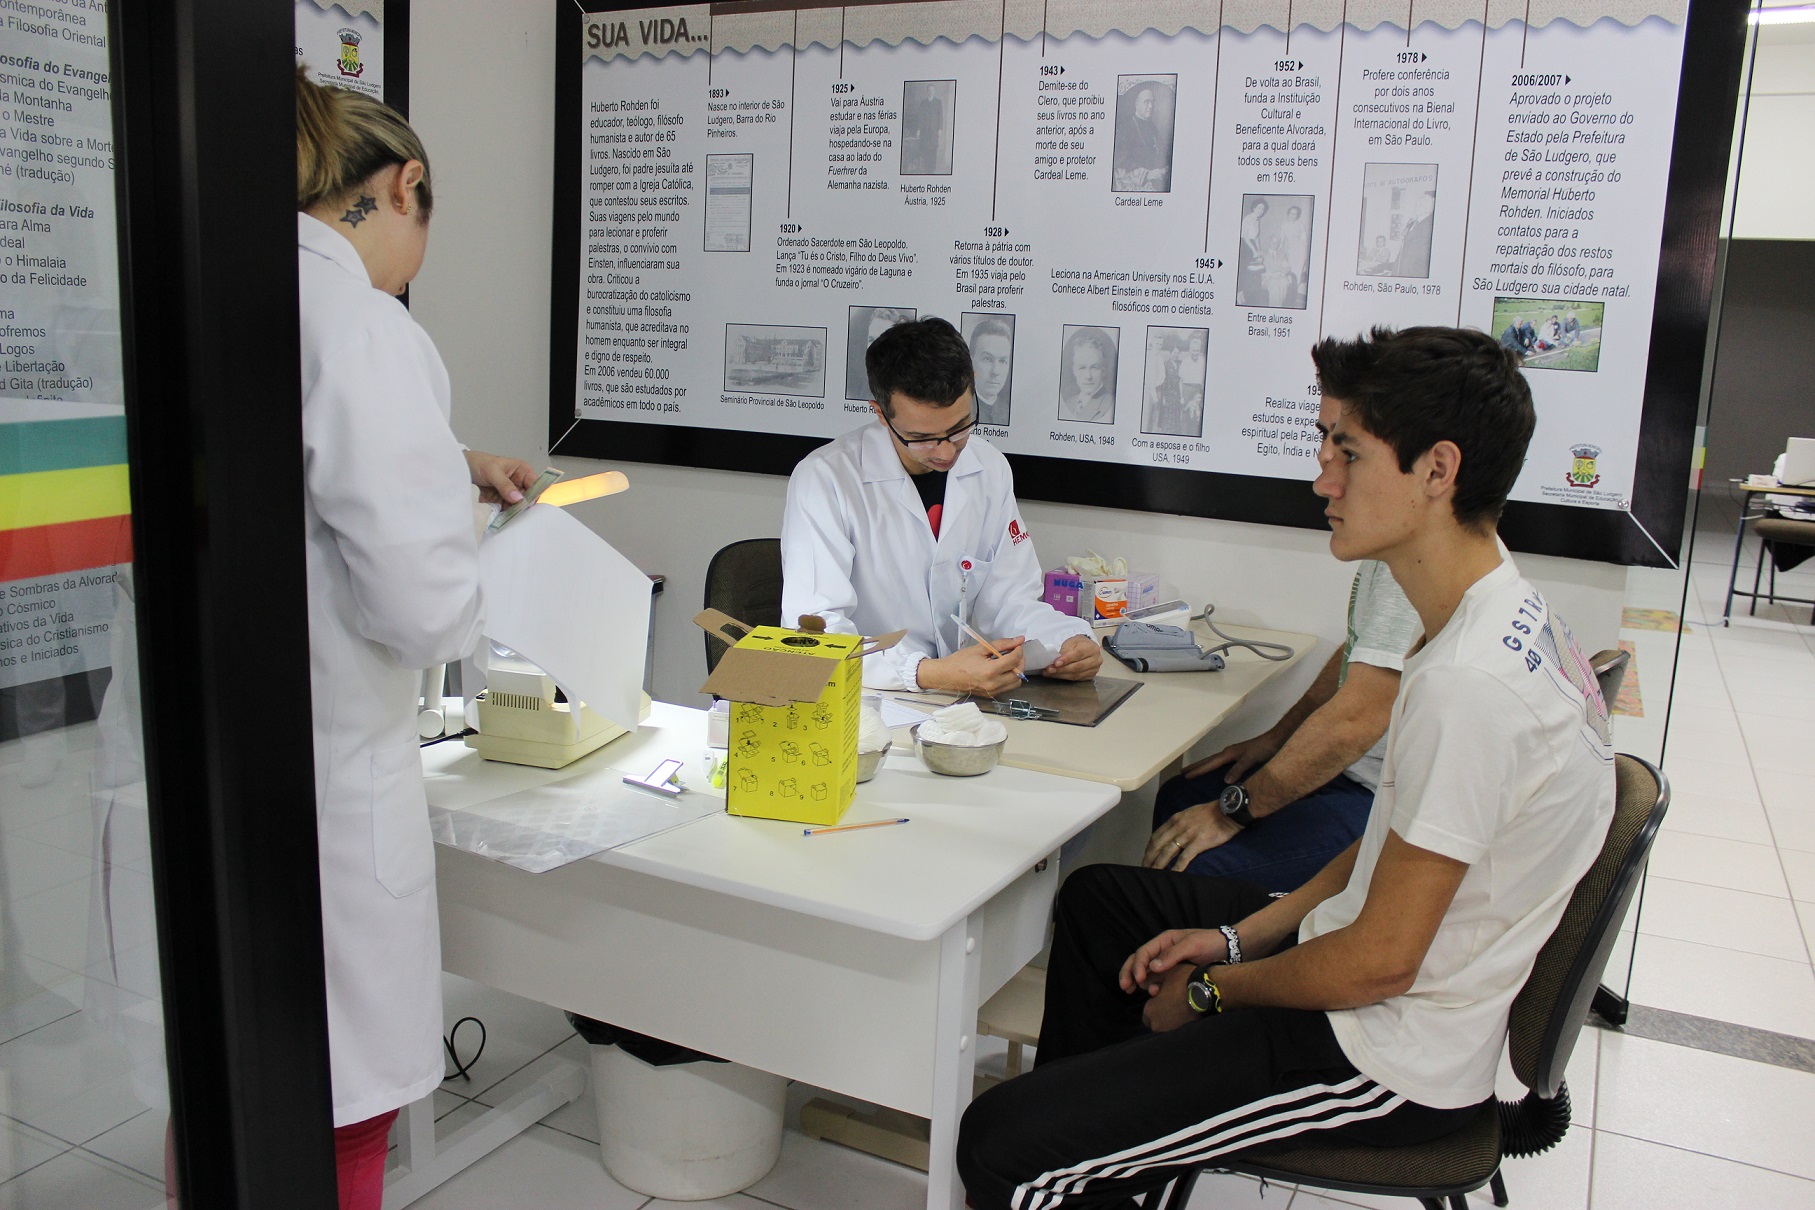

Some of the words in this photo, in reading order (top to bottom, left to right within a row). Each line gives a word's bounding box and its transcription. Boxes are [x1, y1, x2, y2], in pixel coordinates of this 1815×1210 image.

[8, 15, 58, 38] Filosofia
[62, 28, 106, 48] Oriental
[587, 22, 630, 49] SUA
[639, 17, 709, 46] VIDA...
[1397, 52, 1418, 63] 1978
[1040, 65, 1058, 76] 1943
[1274, 60, 1295, 72] 1952
[1363, 69, 1395, 80] Profere
[1397, 68, 1450, 80] conferência
[1511, 74, 1562, 86] 2006/2007
[39, 78, 54, 91] do
[1038, 80, 1077, 91] Demite-se
[1079, 80, 1089, 90] do
[1245, 76, 1257, 88] De
[1260, 77, 1280, 88] volta
[1282, 79, 1293, 87] ao
[1295, 76, 1321, 88] Brasil,
[709, 89, 724, 98] 1893
[832, 84, 848, 94] 1925
[14, 91, 72, 112] Montanha
[591, 101, 619, 112] Huberto
[620, 100, 649, 111] Rohden
[650, 98, 659, 110] foi
[708, 102, 728, 112] Nasce
[729, 103, 737, 111] no
[738, 101, 761, 110] interior
[761, 100, 770, 110] de
[771, 99, 785, 109] São
[830, 97, 841, 107] Vai
[843, 99, 858, 109] para
[1509, 92, 1561, 108] Aprovado
[1564, 95, 1571, 105] o
[1573, 92, 1612, 108] projeto
[2, 111, 10, 120] o
[14, 109, 54, 127] Mestre
[707, 115, 735, 127] Ludgero,
[736, 114, 754, 124] Barra
[755, 114, 764, 123] do
[765, 113, 776, 123] Rio
[1261, 108, 1294, 119] Cultural
[1295, 110, 1301, 119] e
[1508, 111, 1550, 124] enviado
[1552, 114, 1567, 124] ao
[1570, 111, 1617, 124] Governo
[1619, 111, 1634, 124] do
[590, 117, 624, 128] educador,
[626, 116, 655, 129] teólogo,
[657, 114, 684, 126] filósofo
[1236, 123, 1285, 135] Beneficente
[1286, 124, 1326, 135] Alvorada,
[10, 127, 37, 142] Vida
[40, 133, 73, 147] sobre
[76, 139, 83, 148] a
[590, 132, 626, 144] humanista
[628, 134, 633, 143] e
[634, 132, 654, 143] autor
[655, 131, 664, 142] de
[666, 130, 676, 142] 65
[16, 164, 75, 185] (tradução)
[1034, 169, 1063, 180] Cardeal
[1065, 170, 1088, 180] Leme.
[827, 180, 861, 190] Alemanha
[863, 180, 889, 190] nazista.
[900, 184, 925, 193] Huberto
[926, 184, 951, 193] Rohden
[1501, 186, 1551, 200] Memorial
[1552, 188, 1595, 201] Huberto
[931, 196, 946, 206] 1925
[1115, 196, 1142, 206] Cardeal
[1143, 197, 1163, 207] Leme
[50, 204, 65, 216] da
[69, 205, 94, 219] Vida
[21, 219, 51, 233] Alma
[780, 224, 796, 233] 1920
[984, 227, 1002, 237] 1928
[777, 236, 809, 247] Ordenado
[811, 237, 845, 248] Sacerdote
[846, 240, 857, 248] em
[858, 238, 873, 248] São
[874, 238, 908, 251] Leopoldo.
[5, 256, 13, 266] o
[16, 254, 66, 269] Himalaia
[617, 257, 665, 269] influenciaram
[666, 261, 680, 269] sua
[1195, 258, 1215, 269] 1945
[11, 272, 26, 284] da
[30, 272, 87, 287] Felicidade
[956, 268, 969, 278] Em
[971, 269, 989, 280] 1935
[991, 270, 1008, 282] viaja
[1009, 271, 1026, 282] pelo
[1051, 268, 1080, 279] Leciona
[1082, 271, 1092, 280] na
[1093, 270, 1130, 281] American
[1132, 271, 1171, 285] University
[1173, 275, 1187, 283] nos
[1343, 280, 1375, 293] Rohden,
[1377, 282, 1393, 293] São
[1394, 283, 1419, 295] Paulo,
[1422, 285, 1441, 295] 1978
[1472, 277, 1493, 291] São
[1495, 279, 1539, 295] Ludgero
[1541, 283, 1560, 294] sua
[1563, 282, 1599, 296] cidade
[1601, 285, 1630, 297] natal.
[971, 298, 1006, 309] palestras.
[1247, 312, 1267, 323] Entre
[1268, 314, 1293, 324] alunas
[1248, 326, 1270, 337] Brasil,
[1274, 327, 1290, 338] 1951
[5, 360, 65, 375] Libertação
[584, 364, 596, 376] Em
[597, 365, 615, 377] 2006
[617, 367, 643, 378] vendeu
[644, 368, 670, 380] 60.000
[1265, 397, 1296, 410] Realiza
[1049, 431, 1077, 443] Rohden,
[1099, 436, 1115, 446] 1948
[10, 582, 60, 598] Sombras
[63, 578, 76, 590] da
[7, 599, 56, 615] Cósmico
[26, 634, 40, 646] do
[43, 623, 109, 642] Cristianismo
